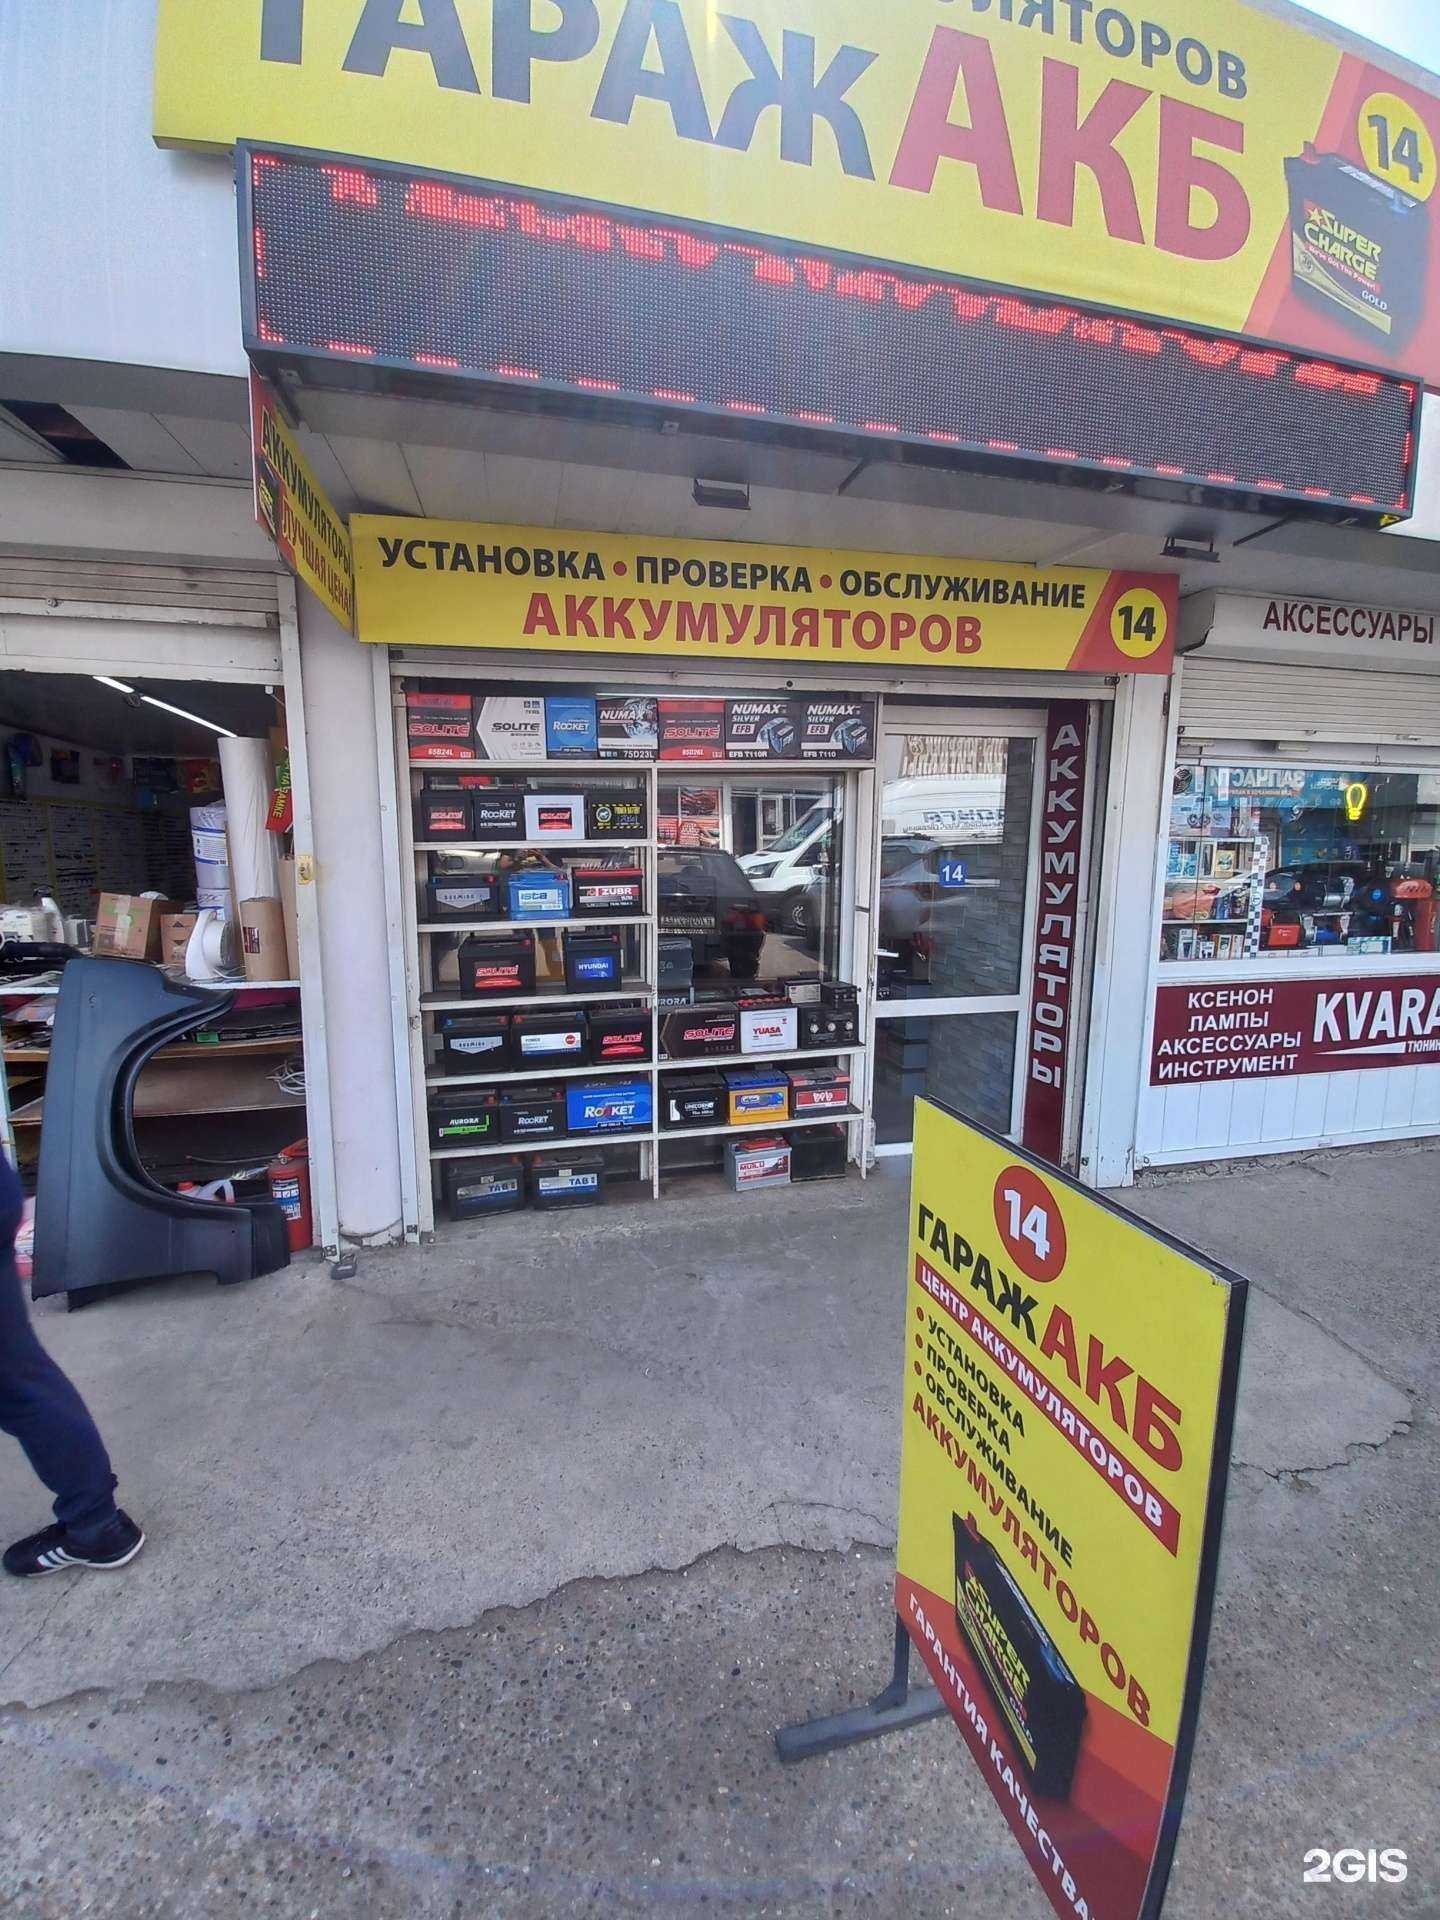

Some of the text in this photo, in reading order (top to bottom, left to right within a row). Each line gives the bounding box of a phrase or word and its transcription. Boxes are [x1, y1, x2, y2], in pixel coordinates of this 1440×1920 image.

[1368, 113, 1423, 184] 14
[1322, 208, 1382, 262] SUPER
[1304, 222, 1378, 281] CHARGE
[1361, 290, 1388, 310] GOLD
[262, 406, 352, 579] АККУМУЛЯТОРЫ
[281, 496, 327, 588] ЛУЧШАЯ
[378, 536, 1086, 609] УСТАНОВКА ПРОВЕРКА ОБСЛУЖИВАНИЕ
[522, 591, 982, 655] АККУМУЛЯТОРОВ
[1117, 604, 1156, 642] 14
[1262, 600, 1434, 645] АКСЕССУАРЫ
[600, 709, 644, 720] NUMAX
[732, 703, 781, 715] NUMAX
[807, 704, 855, 715] NUMAX
[408, 722, 471, 738] SOLITE
[492, 722, 541, 731] SOLITE
[553, 720, 589, 732] ROCKET
[663, 724, 721, 740] SOLITE
[735, 724, 752, 734] EFB
[810, 725, 827, 734] EFB
[480, 809, 516, 819] ROCKET
[942, 864, 964, 882] 14
[602, 887, 632, 896] ZUBR
[1032, 723, 1080, 1089] АККУМУЛЯТОРЫ
[578, 961, 609, 971] HYUNDAI
[1188, 988, 1274, 1010] КСЕНОН
[683, 1024, 735, 1041] SOLITE
[753, 1026, 781, 1035] YUASA
[1188, 1012, 1269, 1033] ЛАМПЫ
[1157, 1032, 1301, 1057] АКСЕССУАРЫ
[1159, 1054, 1298, 1080] ИНСТРУМЕНТ
[518, 1115, 549, 1125] ROCKET
[569, 1177, 588, 1186] TAB
[1003, 1188, 1050, 1261] 14
[928, 1314, 1025, 1438] УСТАНОВКА
[921, 1265, 1162, 1528] ЦЕНТР АККУМУЛЯТОРОВ
[927, 1343, 1011, 1456] ПРОВЕРКА
[926, 1372, 1073, 1569] ОБСЛУЖИВАНИЕ
[912, 1391, 1151, 1728] АККУМУЛЯТОРОВ
[908, 1592, 988, 1745] ГАРАНТИЯ
